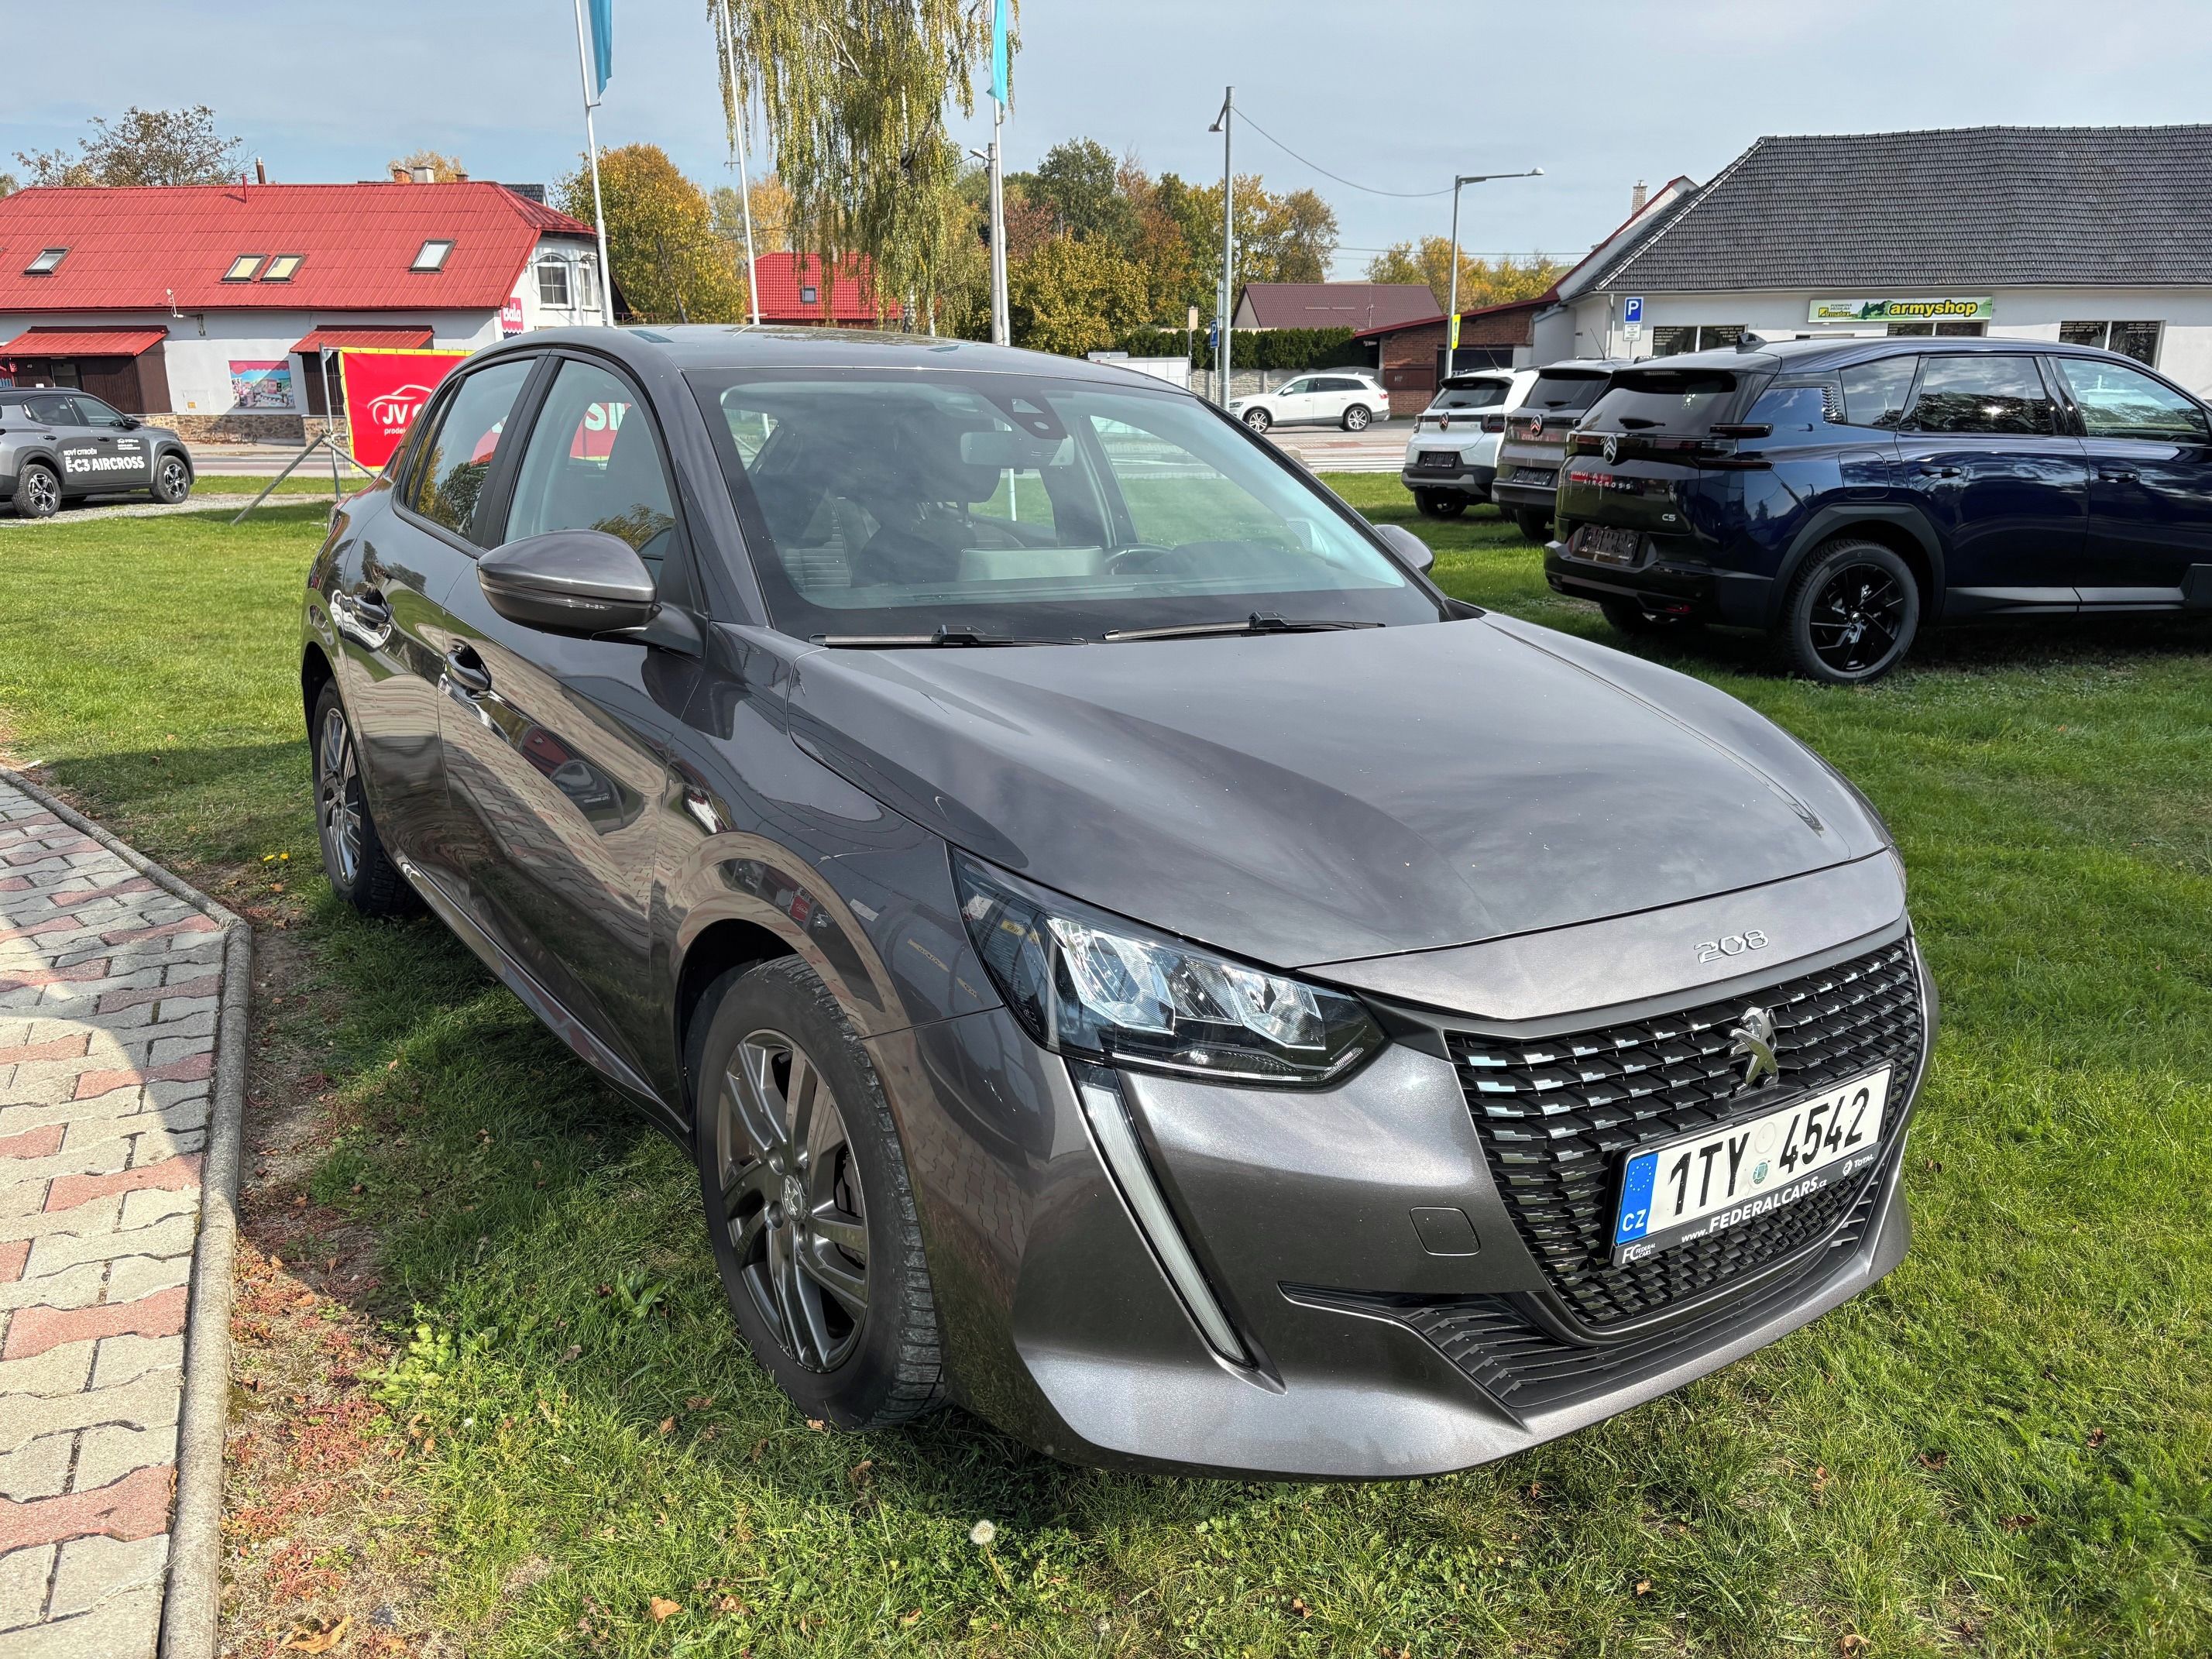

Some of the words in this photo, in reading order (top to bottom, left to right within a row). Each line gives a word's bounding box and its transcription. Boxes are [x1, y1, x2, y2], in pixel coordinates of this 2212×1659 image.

[1627, 301, 1640, 316] P
[1889, 300, 1977, 318] armyshop
[1211, 324, 1217, 340] P
[383, 404, 408, 424] JV
[63, 448, 77, 456] NOVÝ
[77, 447, 98, 455] CITROËN
[91, 455, 146, 471] AIRCROSS
[1583, 479, 1631, 489] AIRCROSS
[1661, 514, 1676, 522] C5
[1694, 929, 1769, 963] 208
[1670, 1132, 1751, 1217] 1TY
[1778, 1086, 1870, 1175] 4542
[1681, 1176, 1828, 1243] www.FEDERALCARS.cz
[1622, 1208, 1647, 1232] CZ
[1621, 1243, 1641, 1264] FC
[1636, 1242, 1656, 1254] FEDERAL
[1638, 1249, 1652, 1258] CARS
